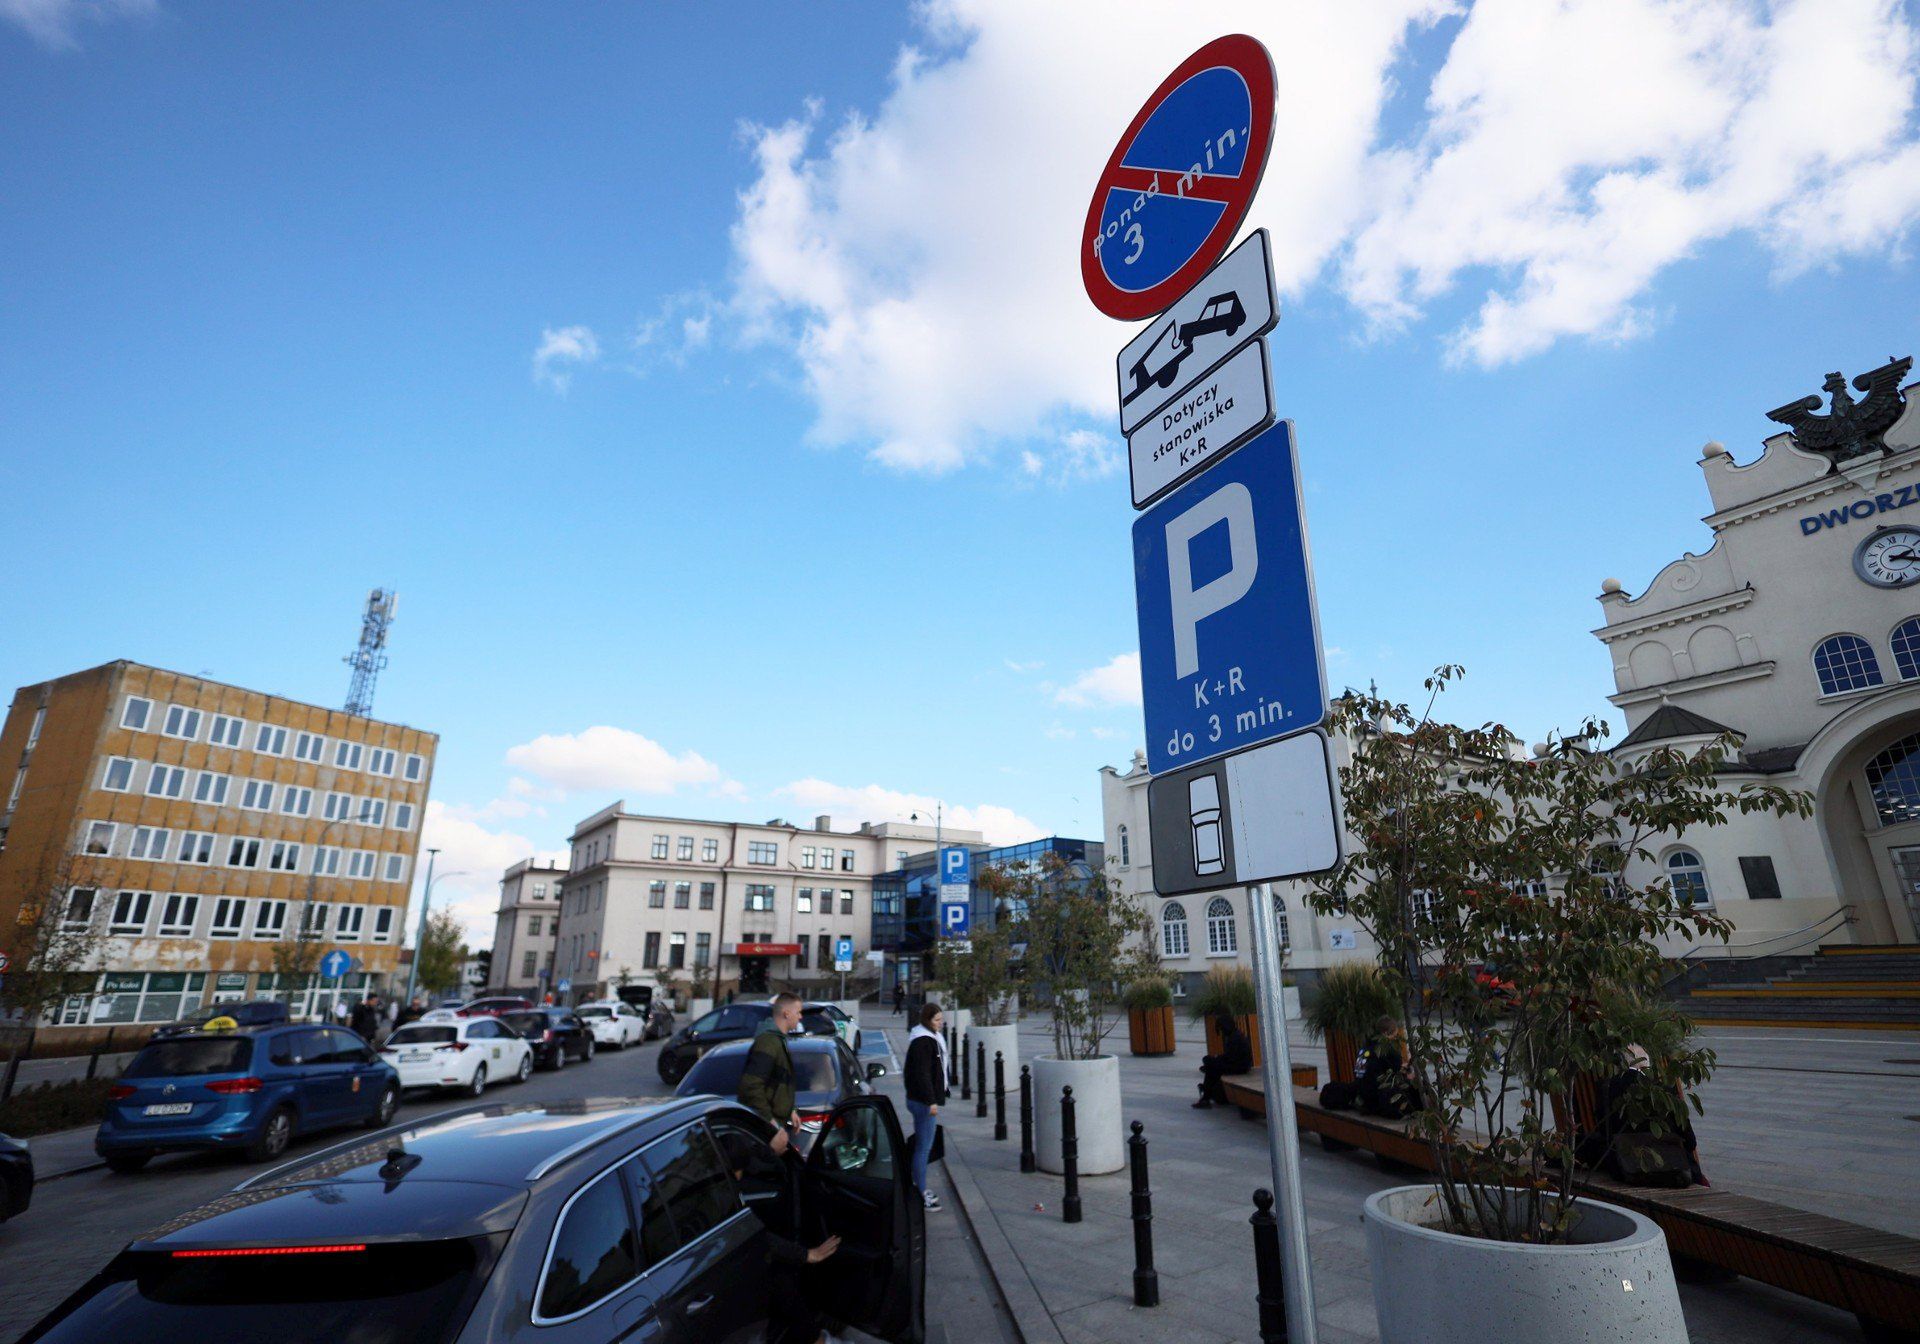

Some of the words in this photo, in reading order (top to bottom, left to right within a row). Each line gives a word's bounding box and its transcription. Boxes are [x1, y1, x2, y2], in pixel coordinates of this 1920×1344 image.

[1093, 173, 1160, 258] ponad
[1124, 223, 1145, 265] 3
[1176, 126, 1248, 199] min.
[1153, 396, 1235, 462] stanowiska
[1162, 384, 1219, 432] Dotyczy
[1179, 437, 1208, 467] K+R
[1165, 482, 1258, 680] P
[1195, 666, 1246, 709] K+R
[1167, 729, 1195, 757] do
[1208, 714, 1222, 743] 3
[1237, 697, 1293, 734] min.
[947, 851, 964, 874] P
[947, 906, 964, 929] P
[839, 942, 850, 955] P
